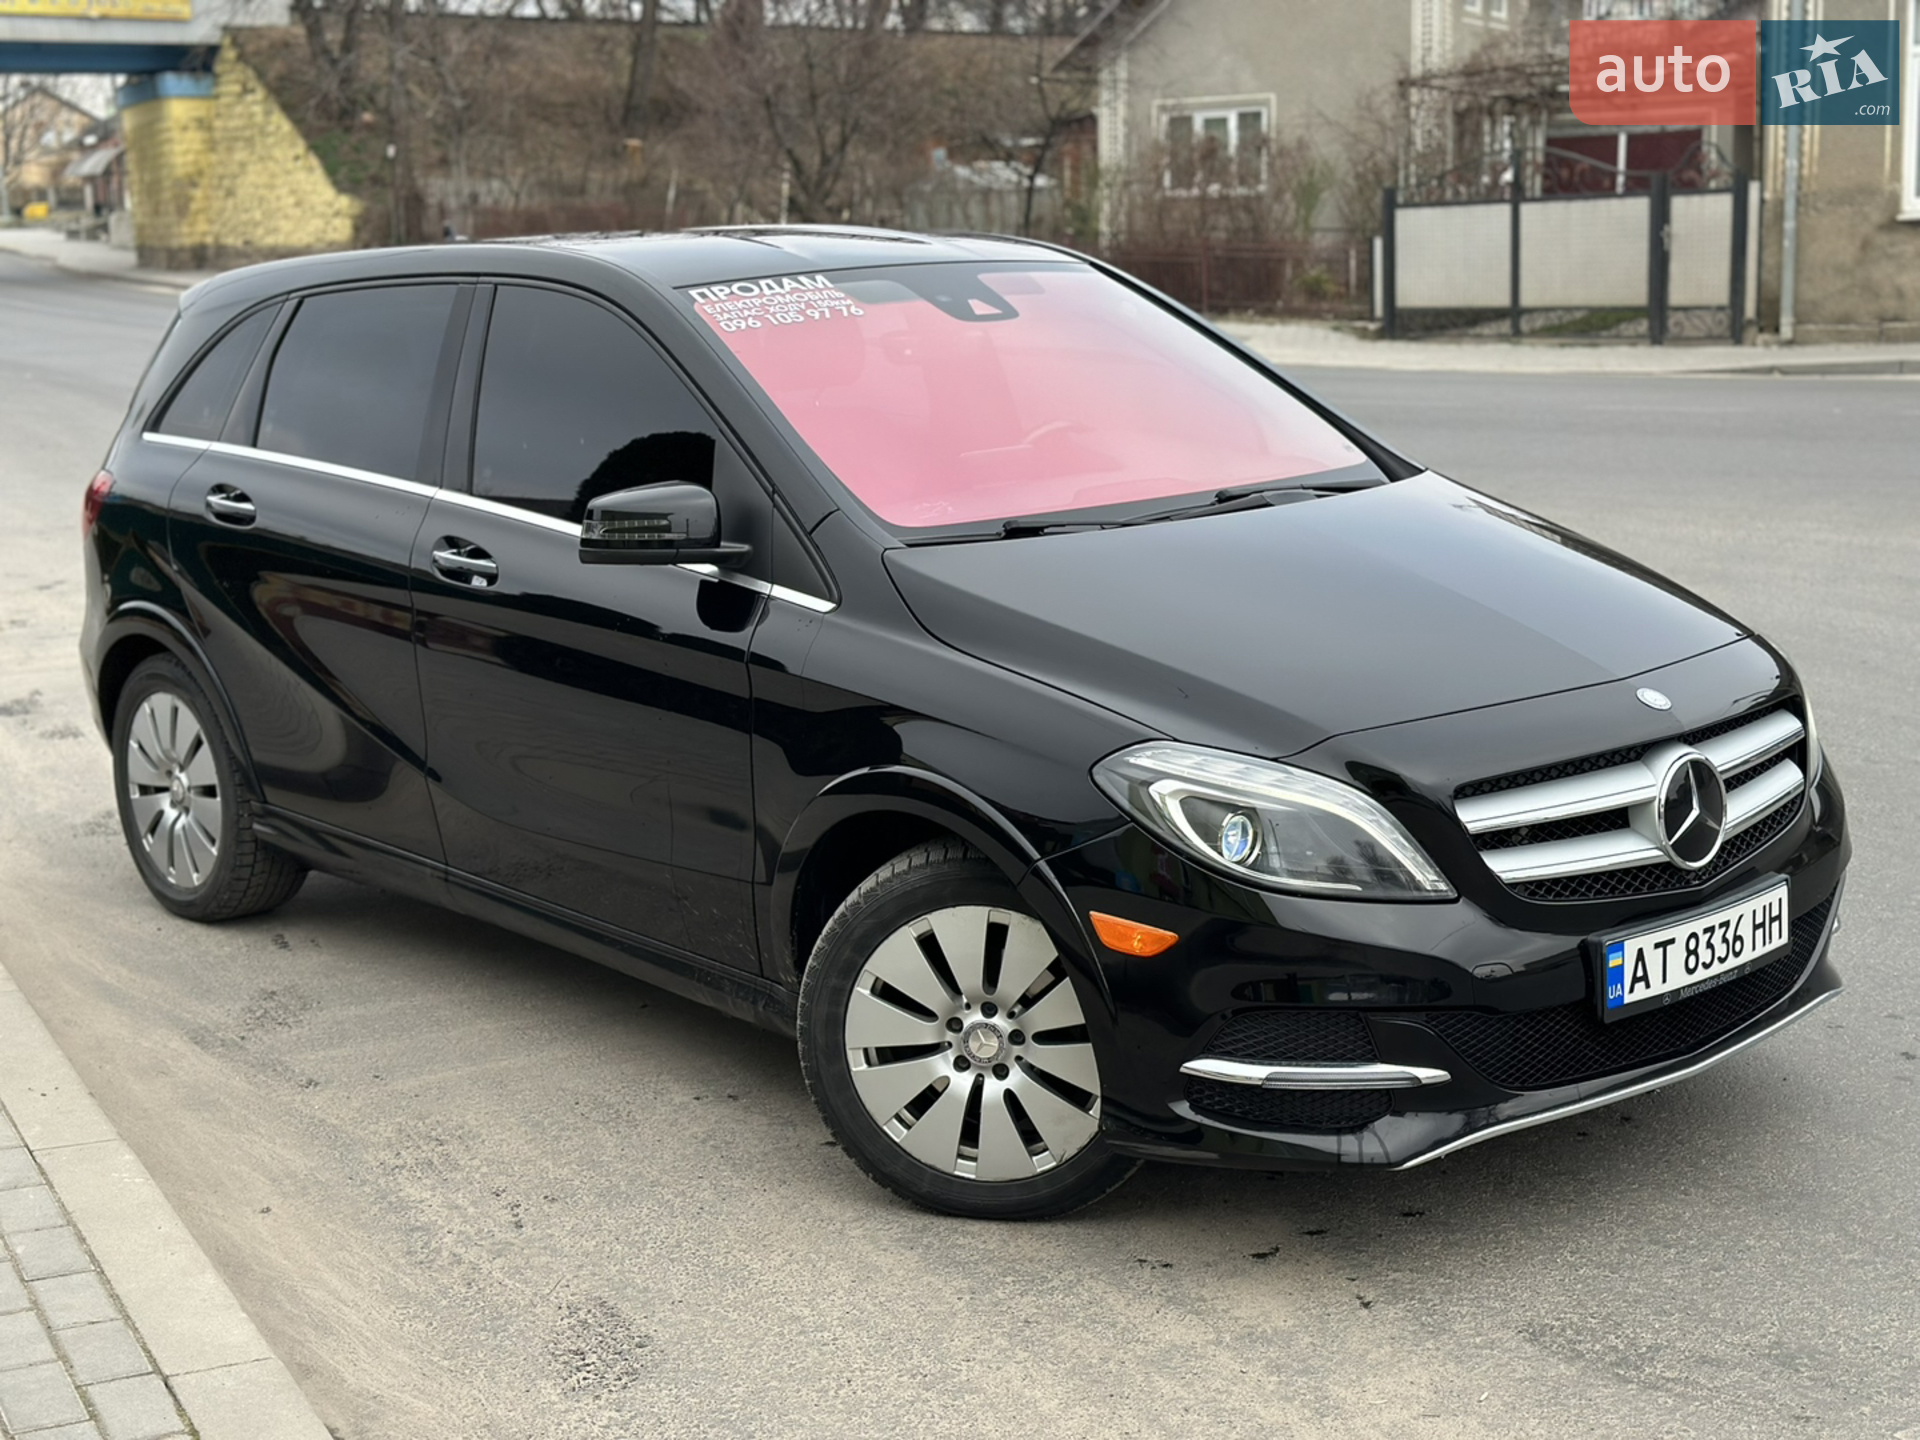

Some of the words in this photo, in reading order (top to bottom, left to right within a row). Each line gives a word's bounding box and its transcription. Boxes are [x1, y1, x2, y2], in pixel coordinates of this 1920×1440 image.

[688, 274, 835, 304] ПРОДАМ
[702, 289, 846, 315] ЕЛЕКТРОМОБІЛЬ
[712, 307, 765, 322] ЗАПАС
[719, 316, 762, 333] 096
[764, 310, 805, 327] 105
[805, 307, 831, 320] 97
[834, 304, 865, 317] 76
[1628, 937, 1677, 996] AT
[1684, 913, 1744, 976] 8336
[1751, 897, 1783, 953] HH
[1608, 983, 1624, 1000] UA
